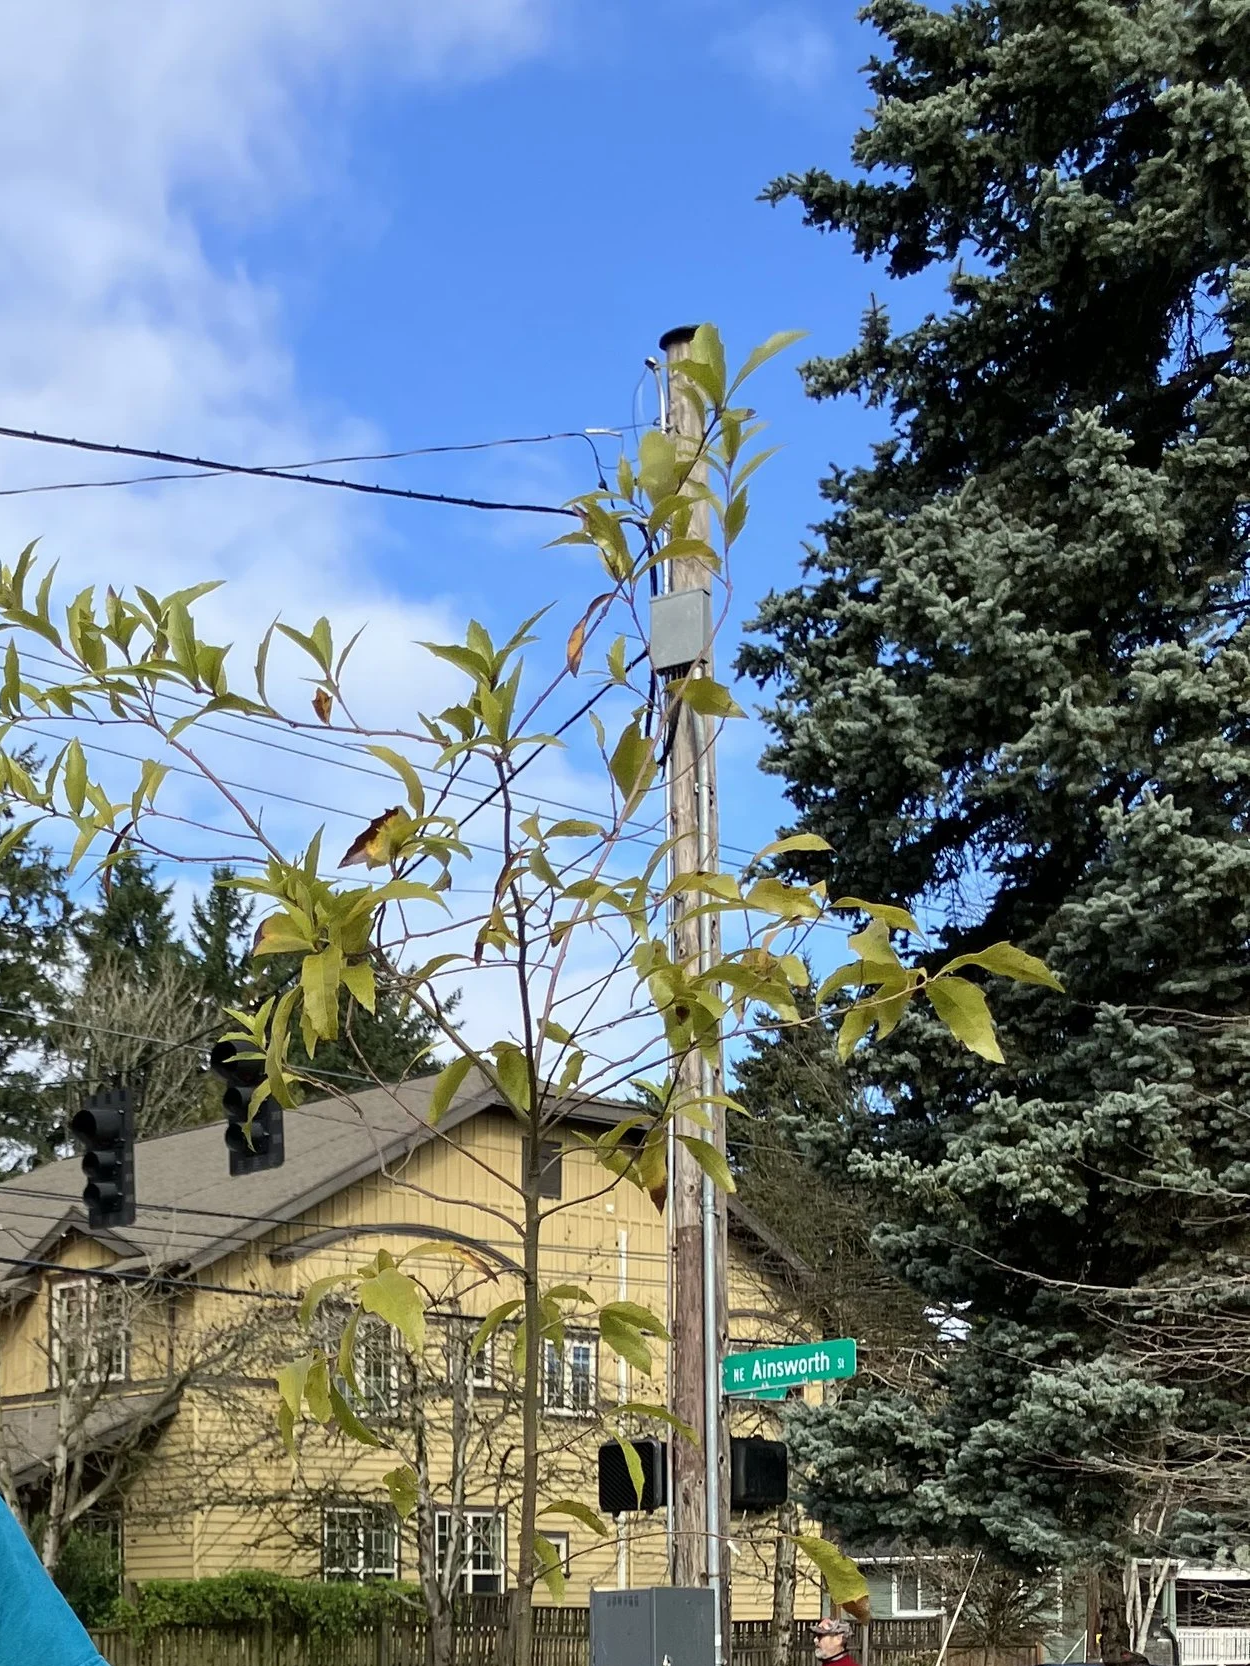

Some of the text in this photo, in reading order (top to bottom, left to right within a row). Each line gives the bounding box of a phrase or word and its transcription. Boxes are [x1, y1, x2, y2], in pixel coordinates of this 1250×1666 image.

[733, 1351, 845, 1383] NE Ainsworth St
